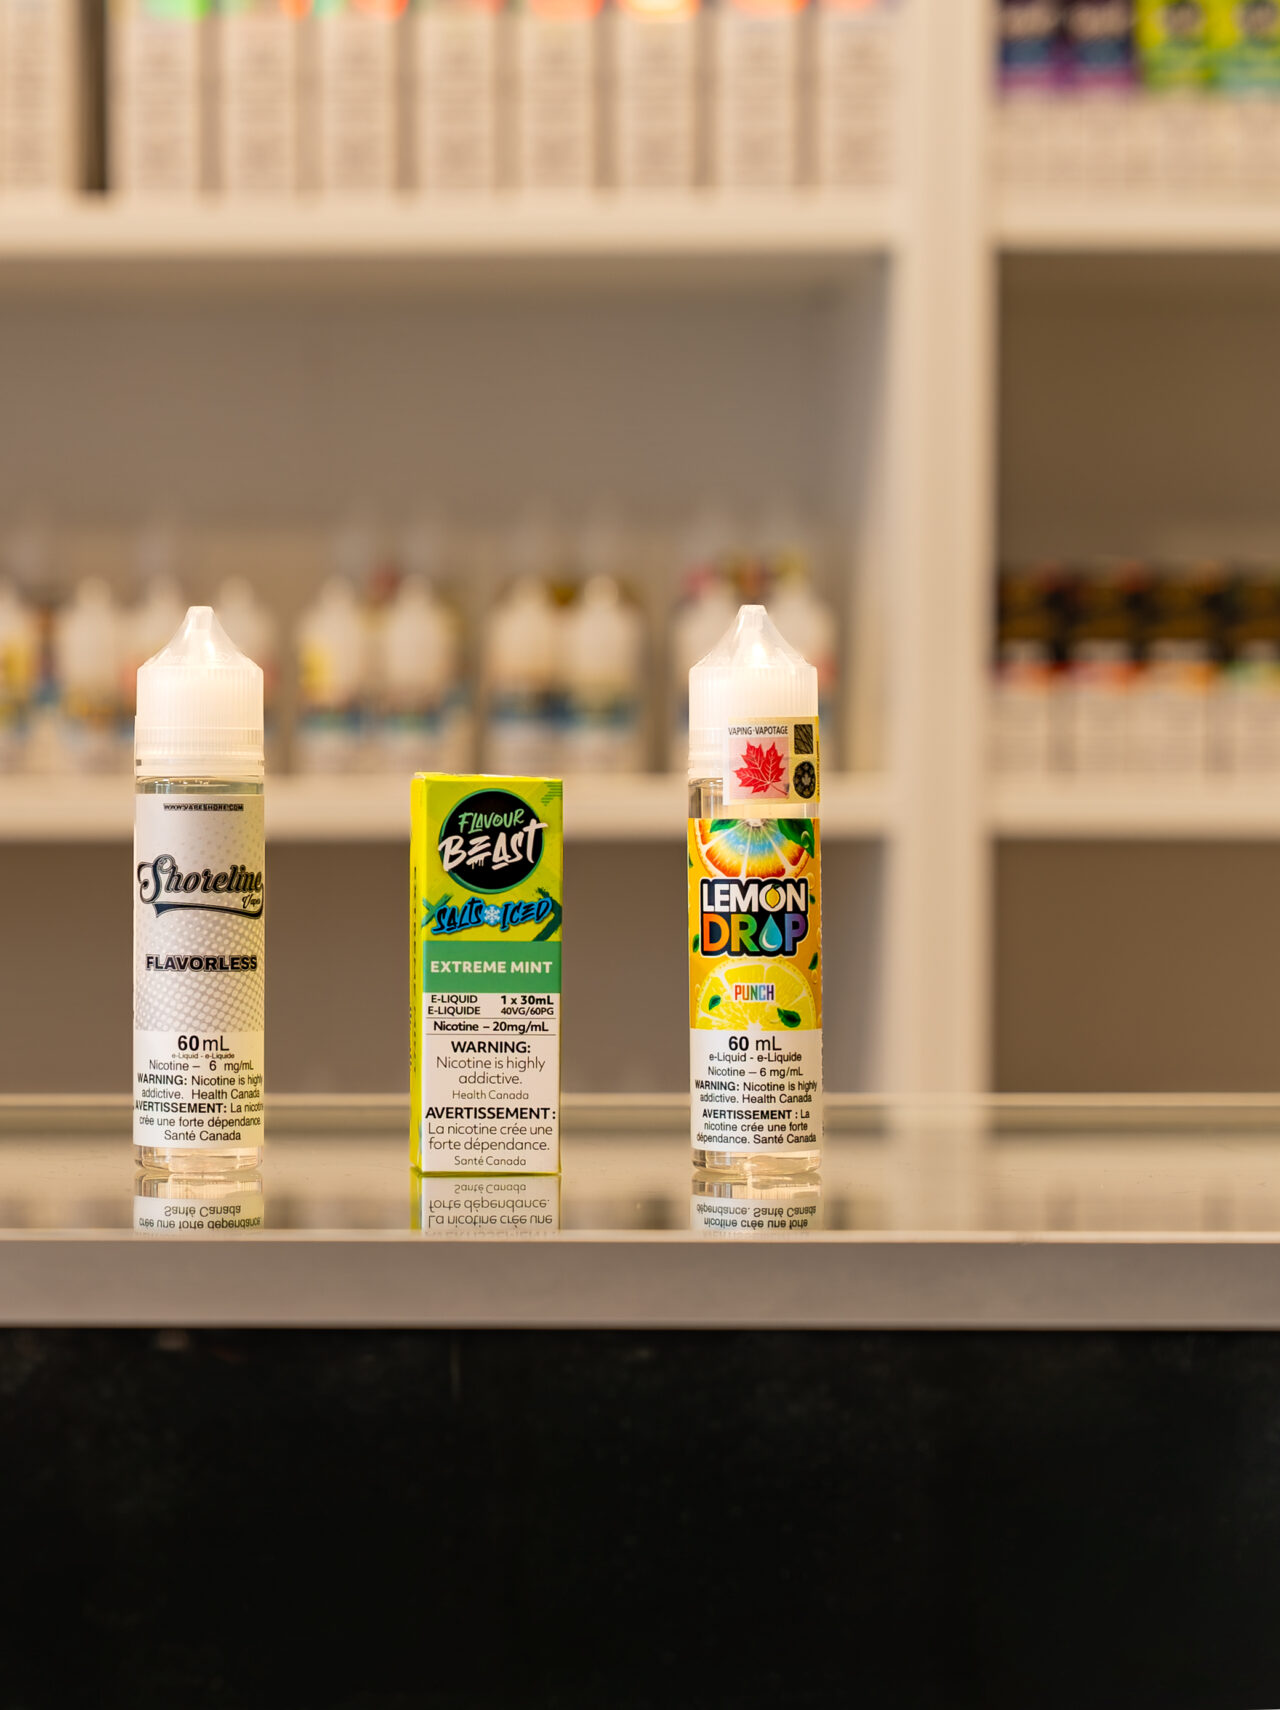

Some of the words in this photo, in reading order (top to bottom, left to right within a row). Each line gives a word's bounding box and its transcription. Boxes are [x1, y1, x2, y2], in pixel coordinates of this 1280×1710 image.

[458, 808, 525, 835] FLAVOUR
[438, 818, 548, 872] BEAST
[137, 854, 262, 904] Shoreline
[702, 883, 806, 912] LEMON
[431, 897, 484, 933] SALTS
[500, 899, 551, 930] ICED
[703, 913, 806, 952] DROP
[146, 955, 258, 972] FLAVORLESS
[430, 961, 507, 974] EXTREME
[510, 961, 553, 974] MINT
[734, 984, 774, 1000] PUNCH
[431, 994, 478, 1005] E-LIQUID
[501, 995, 506, 1005] 1
[511, 997, 517, 1005] x
[520, 995, 554, 1005] 30mL
[427, 1006, 481, 1016] E-LIQUIDE
[501, 1007, 554, 1016] 40VG/60PG
[433, 1021, 479, 1032] Nicotine
[493, 1021, 549, 1035] 20mg/mL
[178, 1035, 199, 1051] 60
[202, 1035, 230, 1051] mL
[451, 1041, 531, 1053] WARNING:
[728, 1036, 749, 1051] 60
[755, 1036, 782, 1051] mL
[436, 1056, 492, 1069] Nicotine
[495, 1057, 503, 1069] is
[507, 1056, 545, 1072] highly
[709, 1053, 747, 1063] e-Liquid
[757, 1052, 802, 1064] e-Liquide
[149, 1060, 189, 1071] Nicotine
[209, 1060, 217, 1071] 6
[224, 1060, 254, 1073] mg/mL
[708, 1066, 745, 1077] Nicotine
[760, 1068, 767, 1077] 6
[769, 1066, 804, 1079] mg/mL
[137, 1073, 188, 1086] WARNING:
[191, 1076, 236, 1086] Nicotine
[238, 1075, 246, 1085] is
[458, 1071, 522, 1084] addictive.
[695, 1079, 740, 1091] WARNING:
[743, 1082, 785, 1092] Nicotine
[788, 1081, 796, 1091] is
[798, 1080, 818, 1093] highly
[142, 1089, 184, 1100] addictive.
[191, 1089, 228, 1100] Health
[230, 1088, 260, 1099] Canada
[452, 1090, 486, 1100] Health
[488, 1090, 529, 1100] Canada
[700, 1093, 739, 1103] addictive.
[742, 1093, 776, 1104] Health
[779, 1093, 812, 1103] Canada
[135, 1100, 227, 1113] AVERTISSEMENT:
[230, 1103, 242, 1113] La
[800, 1109, 810, 1119] La
[139, 1115, 154, 1126] crée
[157, 1118, 176, 1127] une
[179, 1117, 204, 1128] forte
[704, 1121, 738, 1132] nicotine
[741, 1122, 764, 1132] crée
[767, 1124, 786, 1132] une
[789, 1122, 808, 1131] forte
[164, 1129, 196, 1141] Santé
[199, 1130, 242, 1141] Canada
[428, 1123, 445, 1135] La
[448, 1123, 497, 1135] nicotine
[500, 1123, 527, 1135] crée
[530, 1126, 553, 1135] une
[429, 1137, 461, 1150] forte
[464, 1137, 550, 1153] dépendance.
[753, 1133, 783, 1144] Santé
[786, 1133, 817, 1144] Canada
[454, 1156, 484, 1166] Santé
[485, 1156, 527, 1166] Canada
